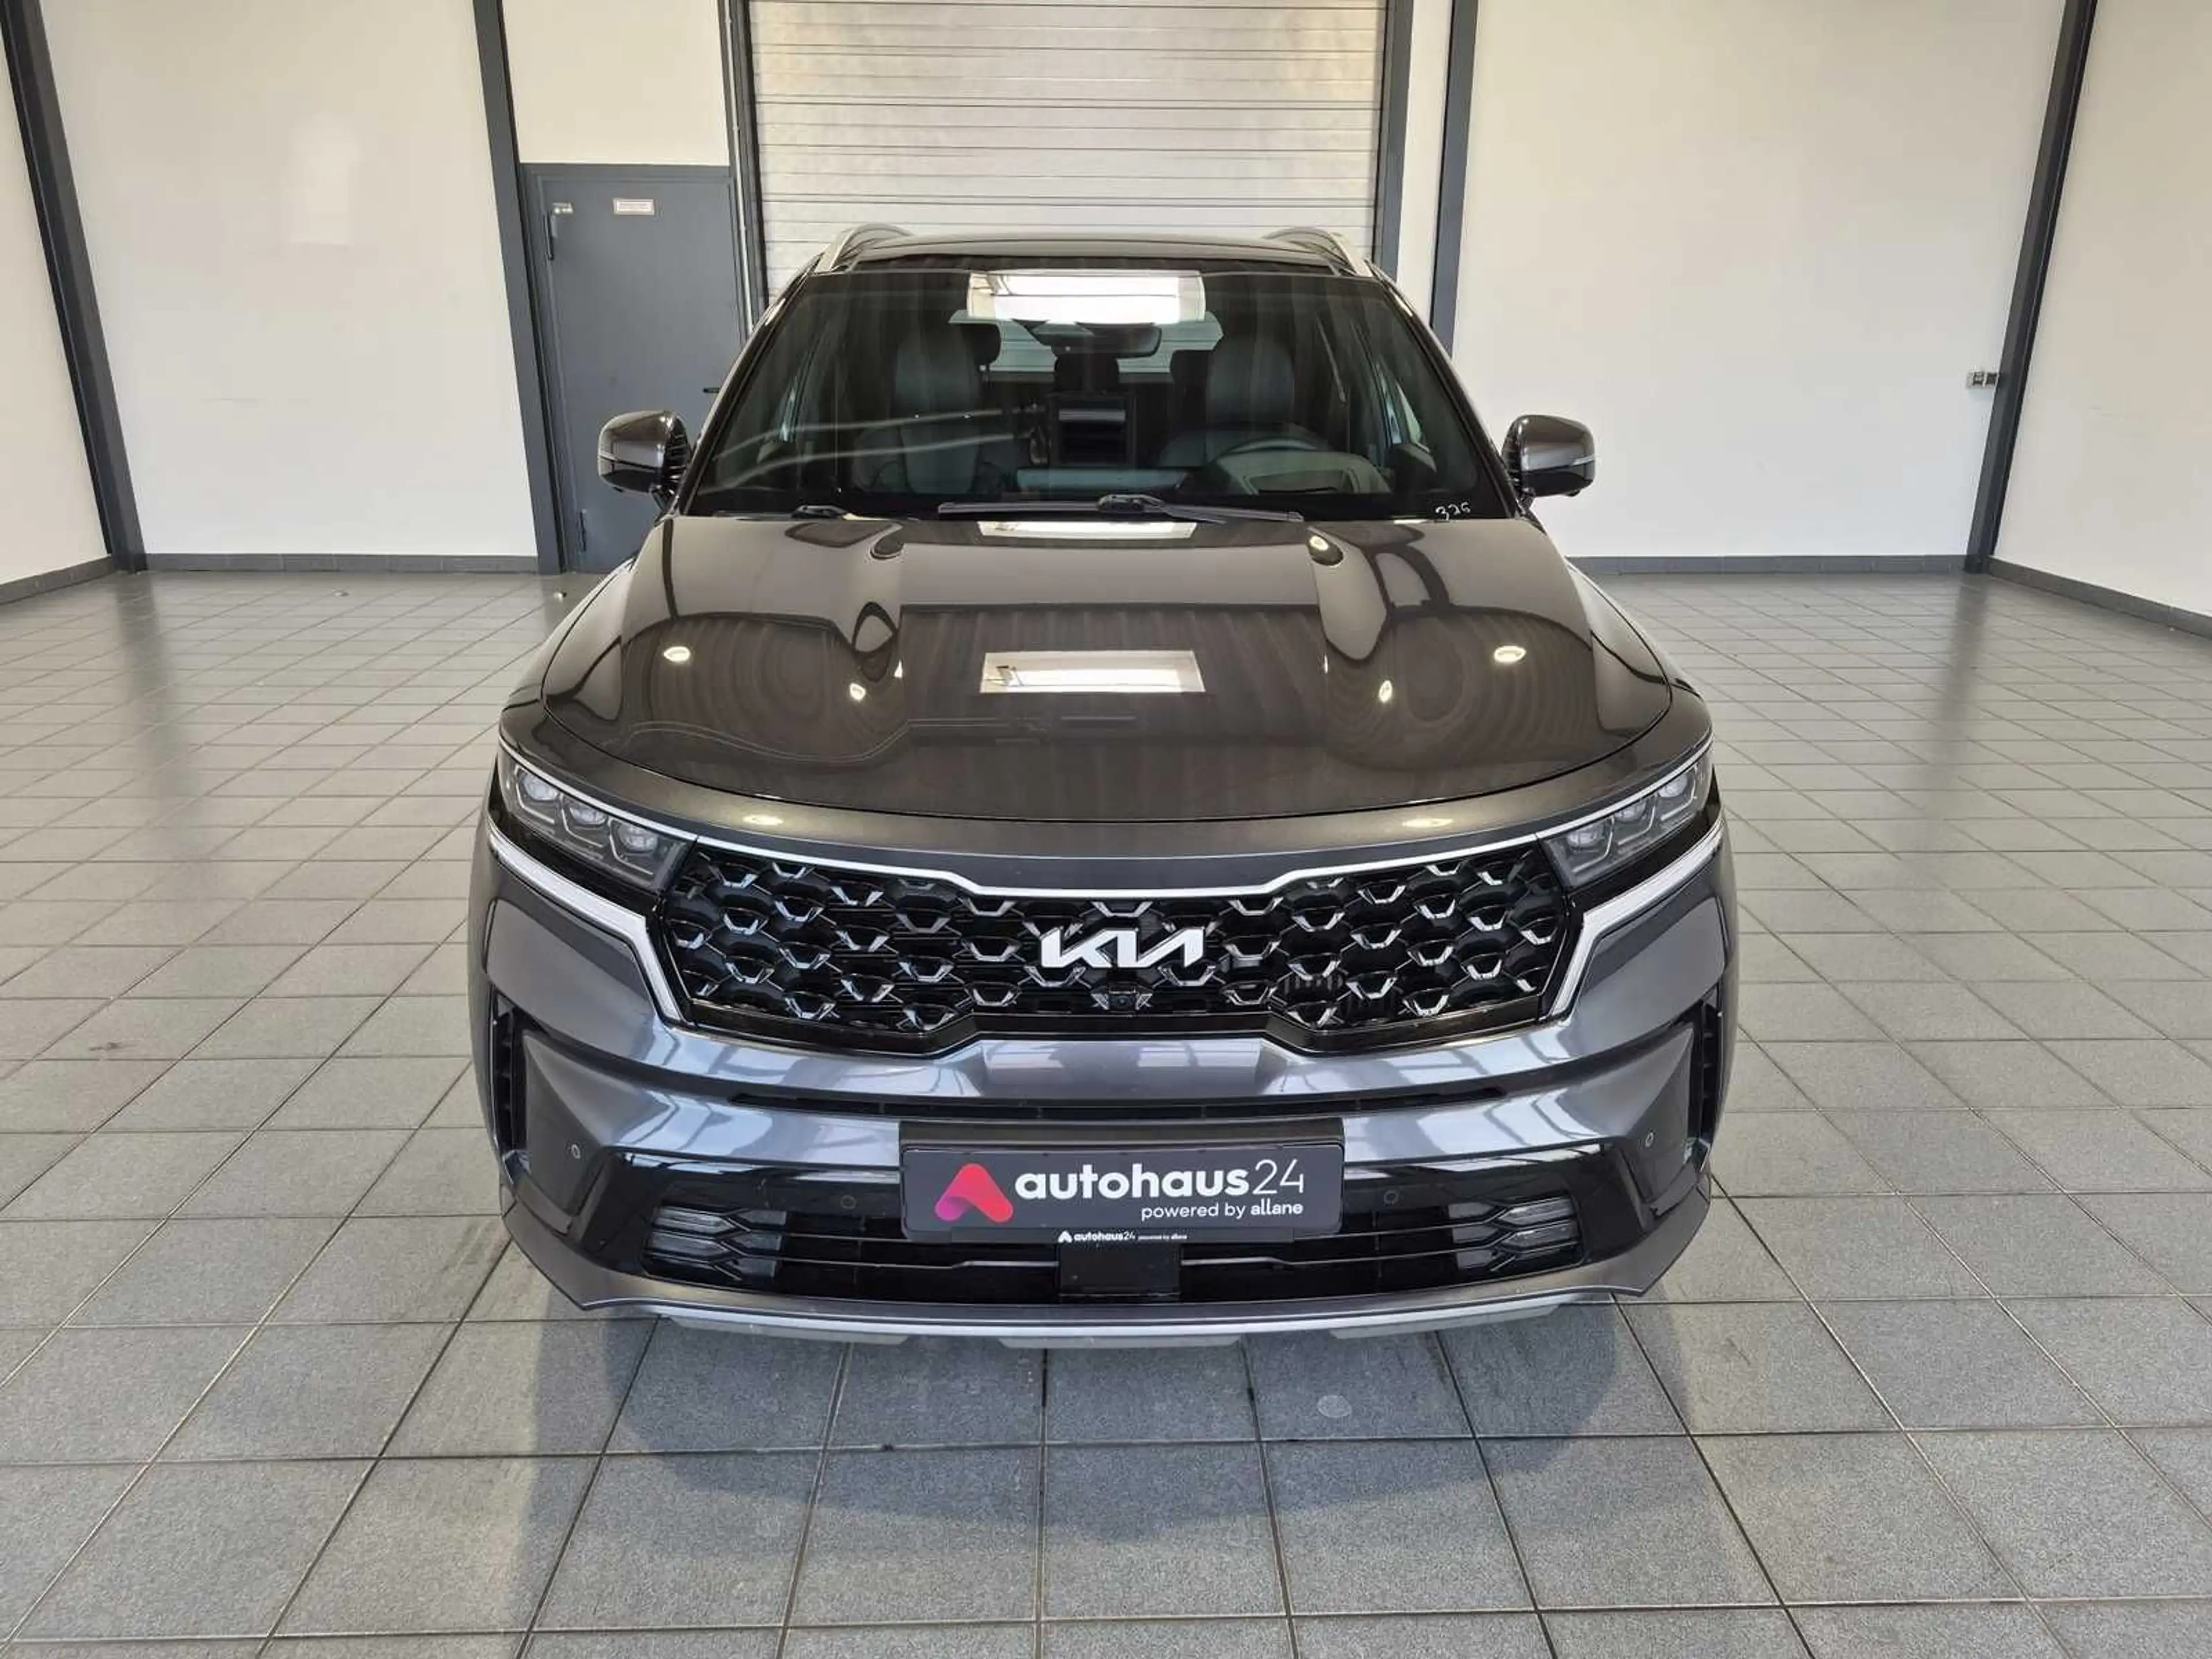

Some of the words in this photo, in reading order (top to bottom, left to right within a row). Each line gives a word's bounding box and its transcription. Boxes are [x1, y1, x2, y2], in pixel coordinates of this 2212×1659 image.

[1040, 927, 1205, 968] KIA
[1014, 1158, 1304, 1200] autohaus24
[1141, 1202, 1219, 1222] powered
[1224, 1202, 1247, 1219] by
[1250, 1198, 1304, 1216] allane
[1073, 1230, 1137, 1242] autohaus24
